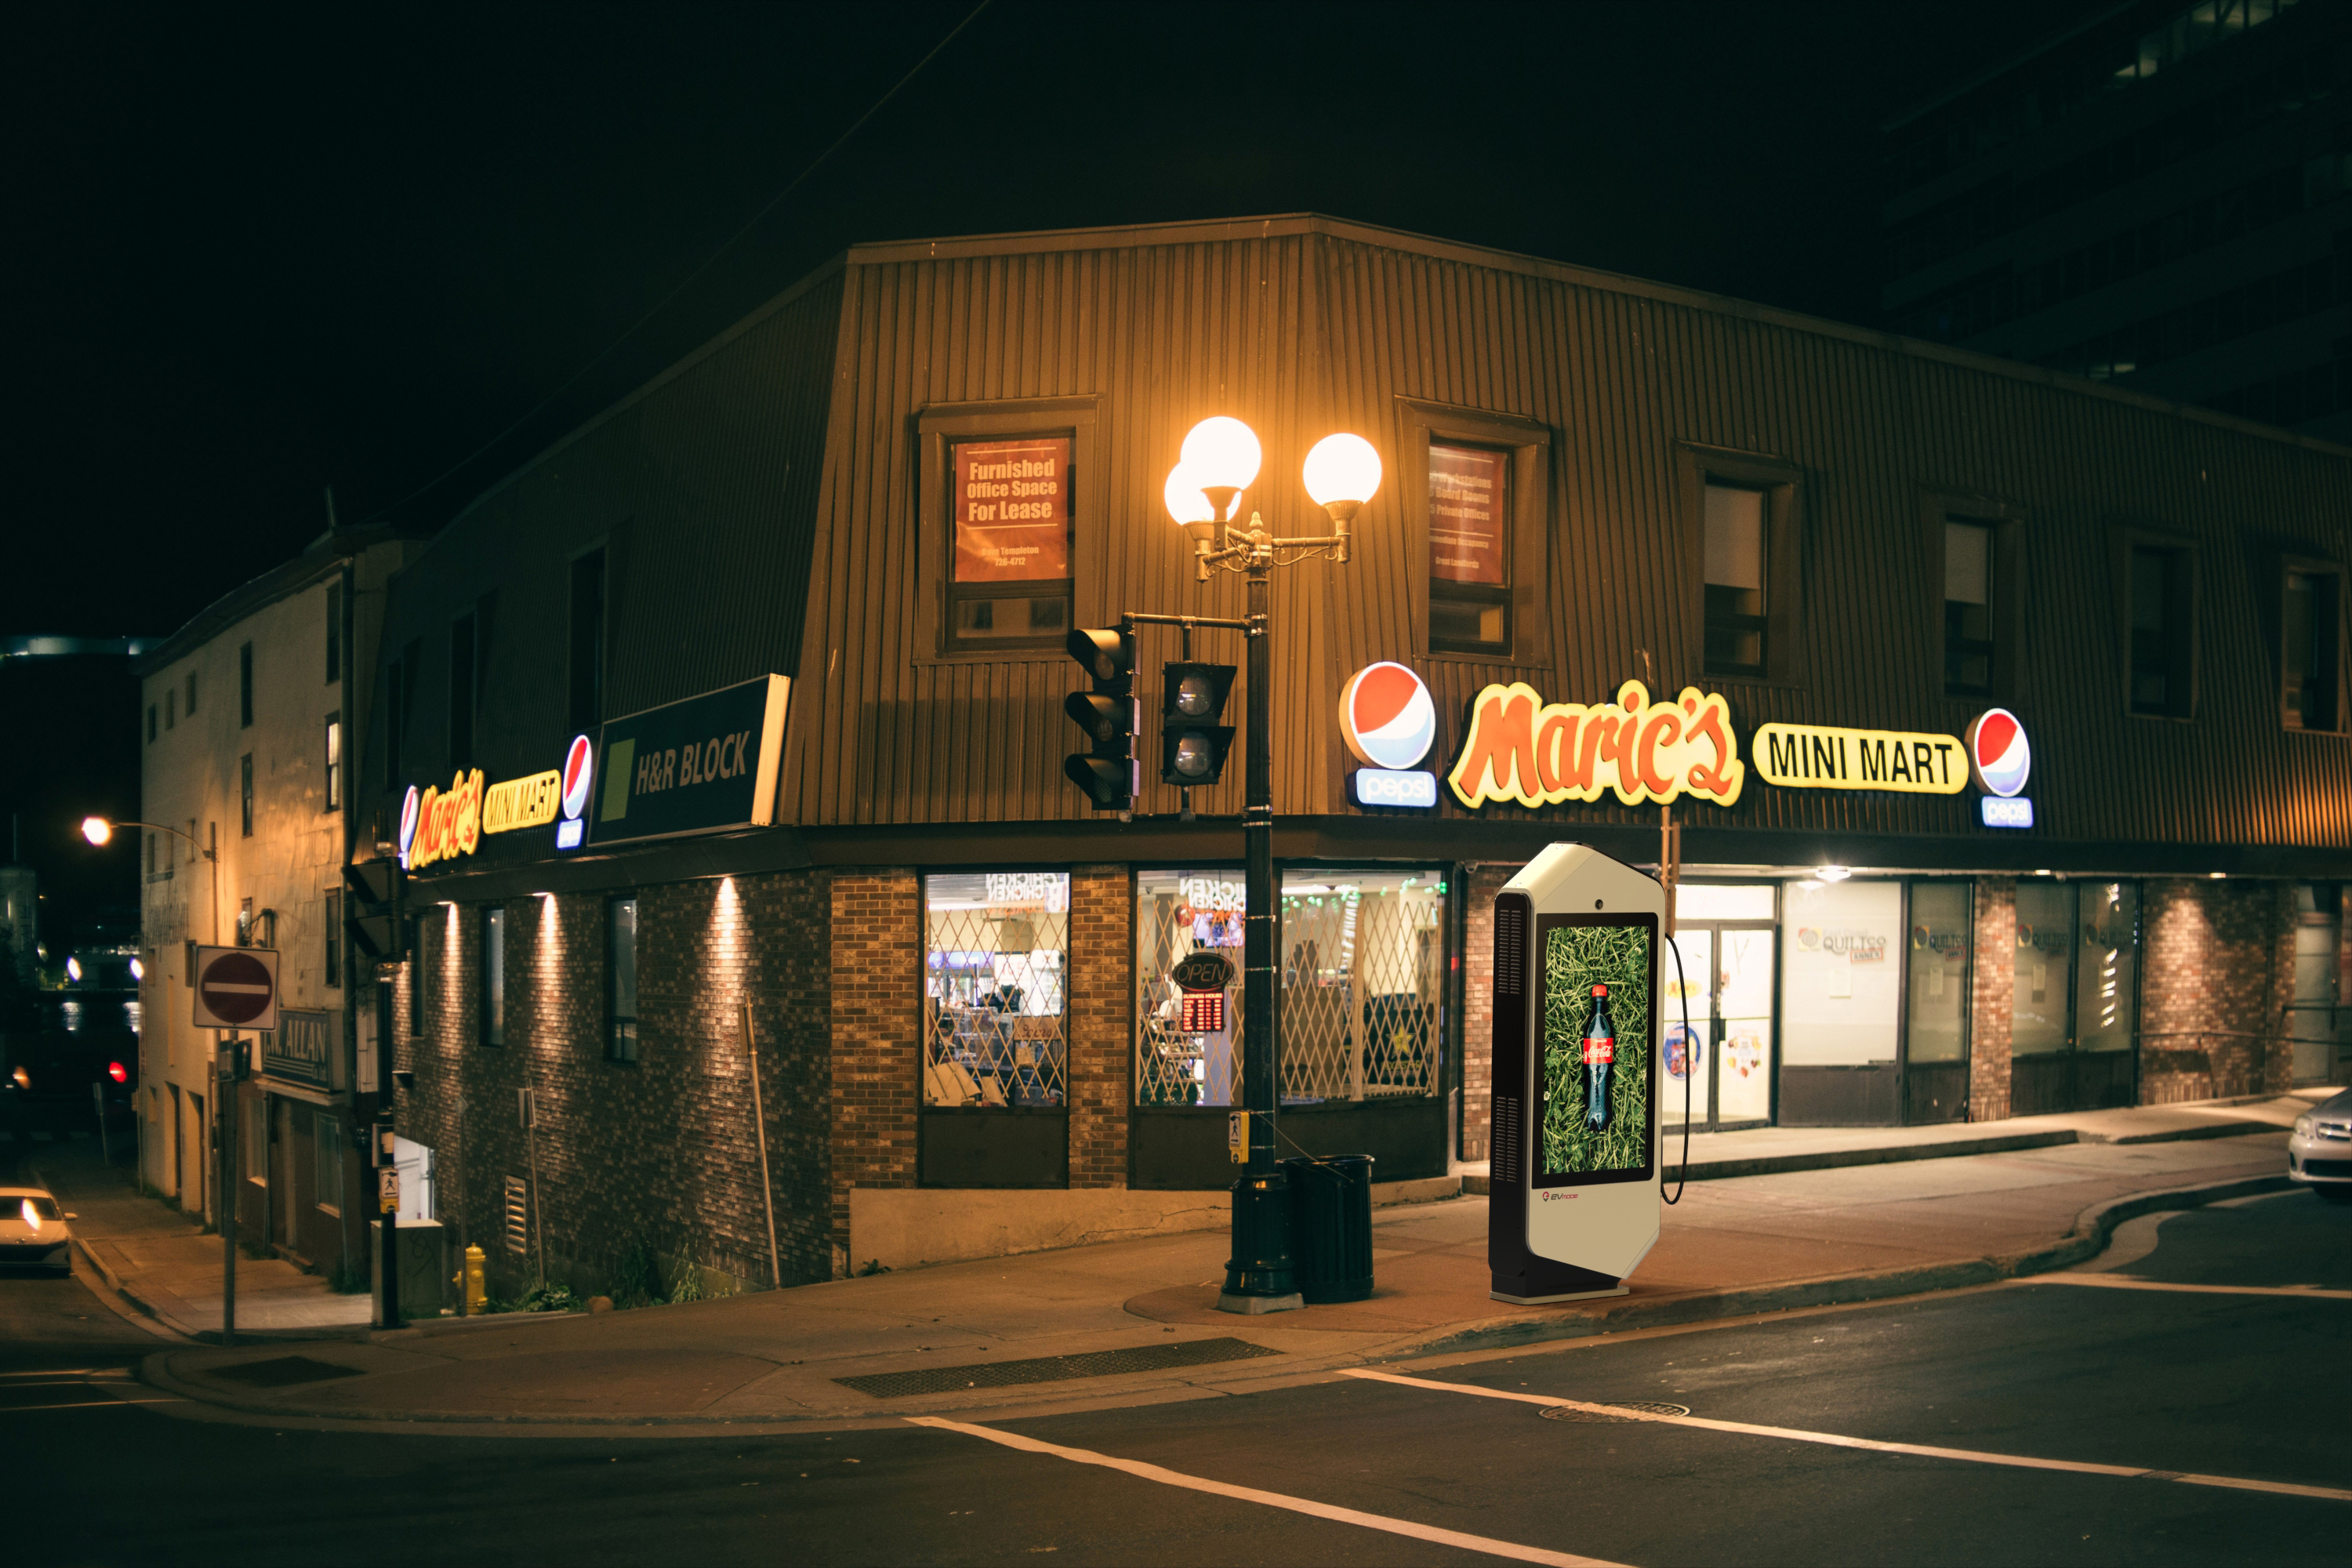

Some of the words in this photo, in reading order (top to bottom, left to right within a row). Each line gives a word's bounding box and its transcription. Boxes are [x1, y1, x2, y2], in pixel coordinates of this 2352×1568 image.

[970, 459, 1054, 480] Furnished
[967, 482, 1009, 499] Office
[1011, 481, 1058, 497] Space
[1436, 487, 1461, 501] Board
[1462, 489, 1490, 504] Rooms
[968, 503, 996, 521] For
[1000, 501, 1052, 520] Lease
[1436, 505, 1463, 517] Private
[1464, 507, 1490, 521] Offices
[1429, 535, 1457, 546] mmediate
[1000, 546, 1039, 556] Templeton
[995, 557, 1025, 566] 726-4712
[1457, 691, 1733, 799] Marie's
[636, 749, 676, 795] H&R
[680, 731, 750, 786] BLOCK
[1769, 732, 1847, 779] MINI
[1860, 738, 1952, 784] MART
[1366, 775, 1429, 801] pepsi
[486, 786, 517, 827] MINI
[517, 776, 555, 822] MART
[1987, 800, 2028, 825] pepsi
[1177, 964, 1227, 982] OPEN
[285, 1019, 327, 1063] ALLAN
